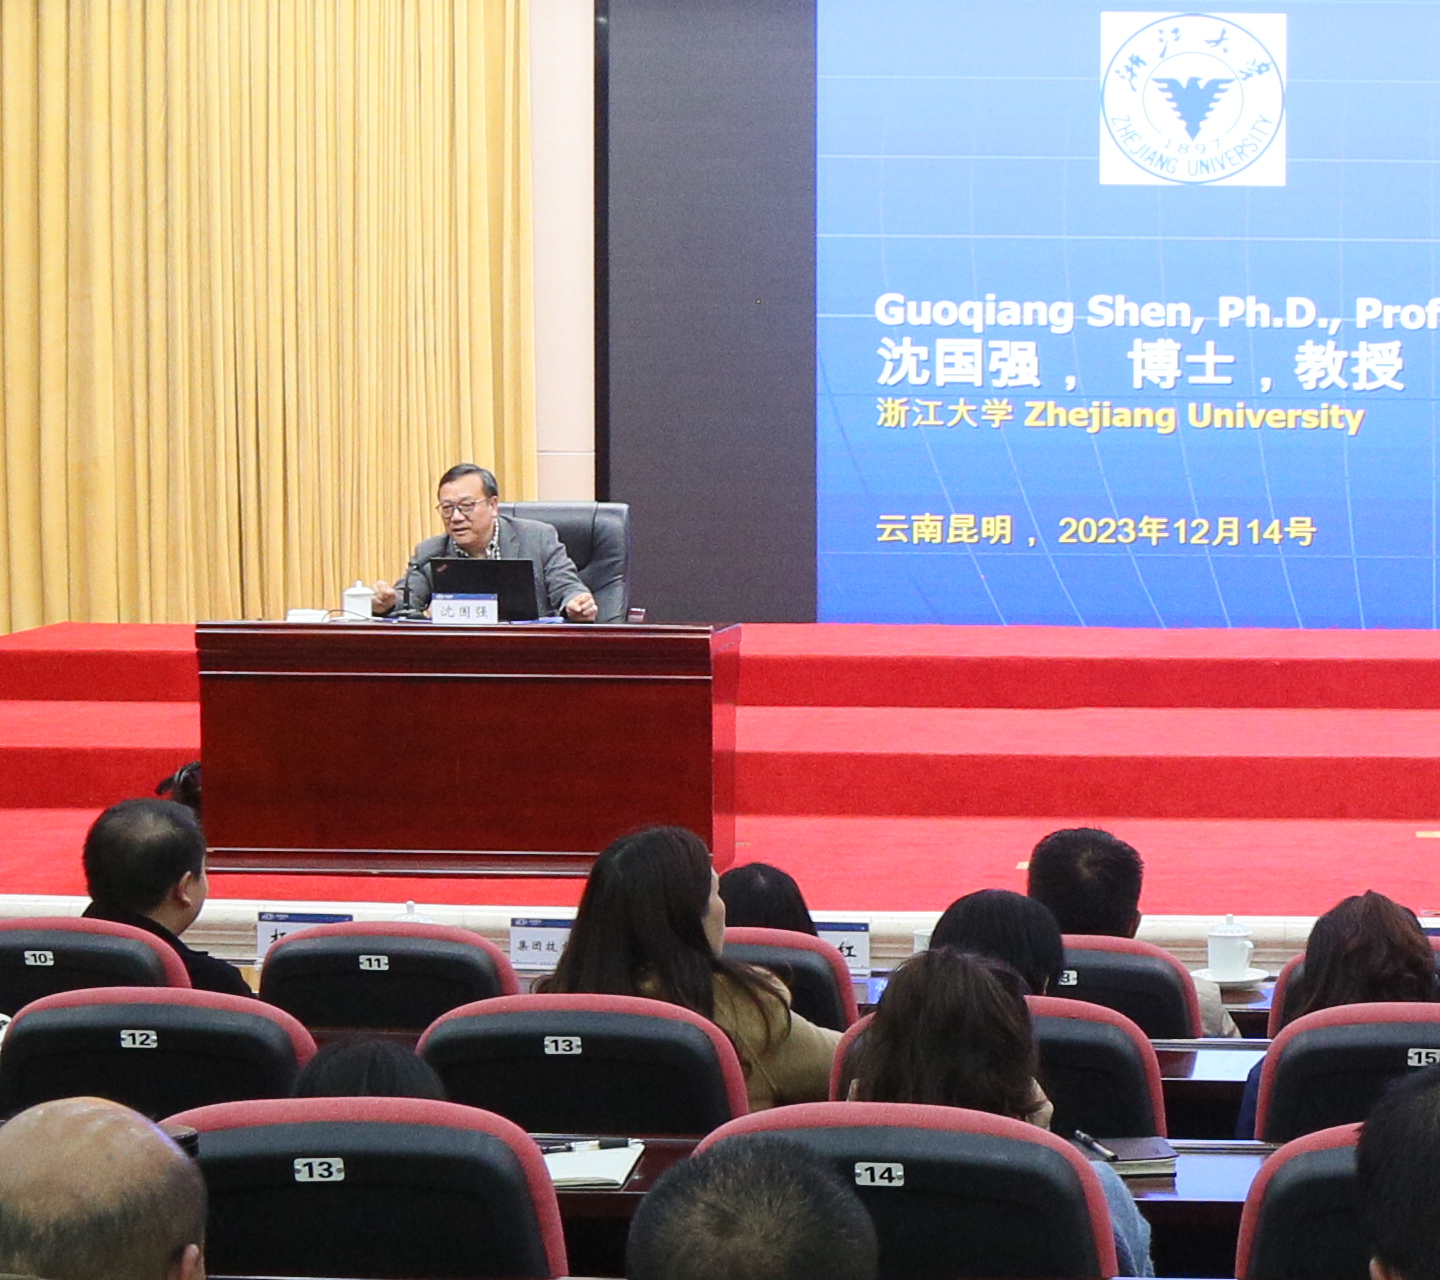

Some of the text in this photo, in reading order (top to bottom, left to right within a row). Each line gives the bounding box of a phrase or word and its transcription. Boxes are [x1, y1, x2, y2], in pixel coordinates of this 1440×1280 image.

[1111, 113, 1273, 176] ZHEJIANG UNIVERSITY
[874, 293, 1074, 335] Guoqiang
[1087, 294, 1203, 332] Shen,
[1218, 296, 1341, 333] Ph.D.,
[875, 397, 1366, 437] 浙江大学 Zhejiang University
[517, 939, 568, 952] 集团技
[32, 952, 47, 964] 10
[364, 957, 381, 968] 11
[129, 1032, 151, 1046] 12
[552, 1038, 573, 1052] 13
[1413, 1050, 1436, 1064] 15
[303, 1161, 333, 1178] 13
[863, 1165, 895, 1183] 14
